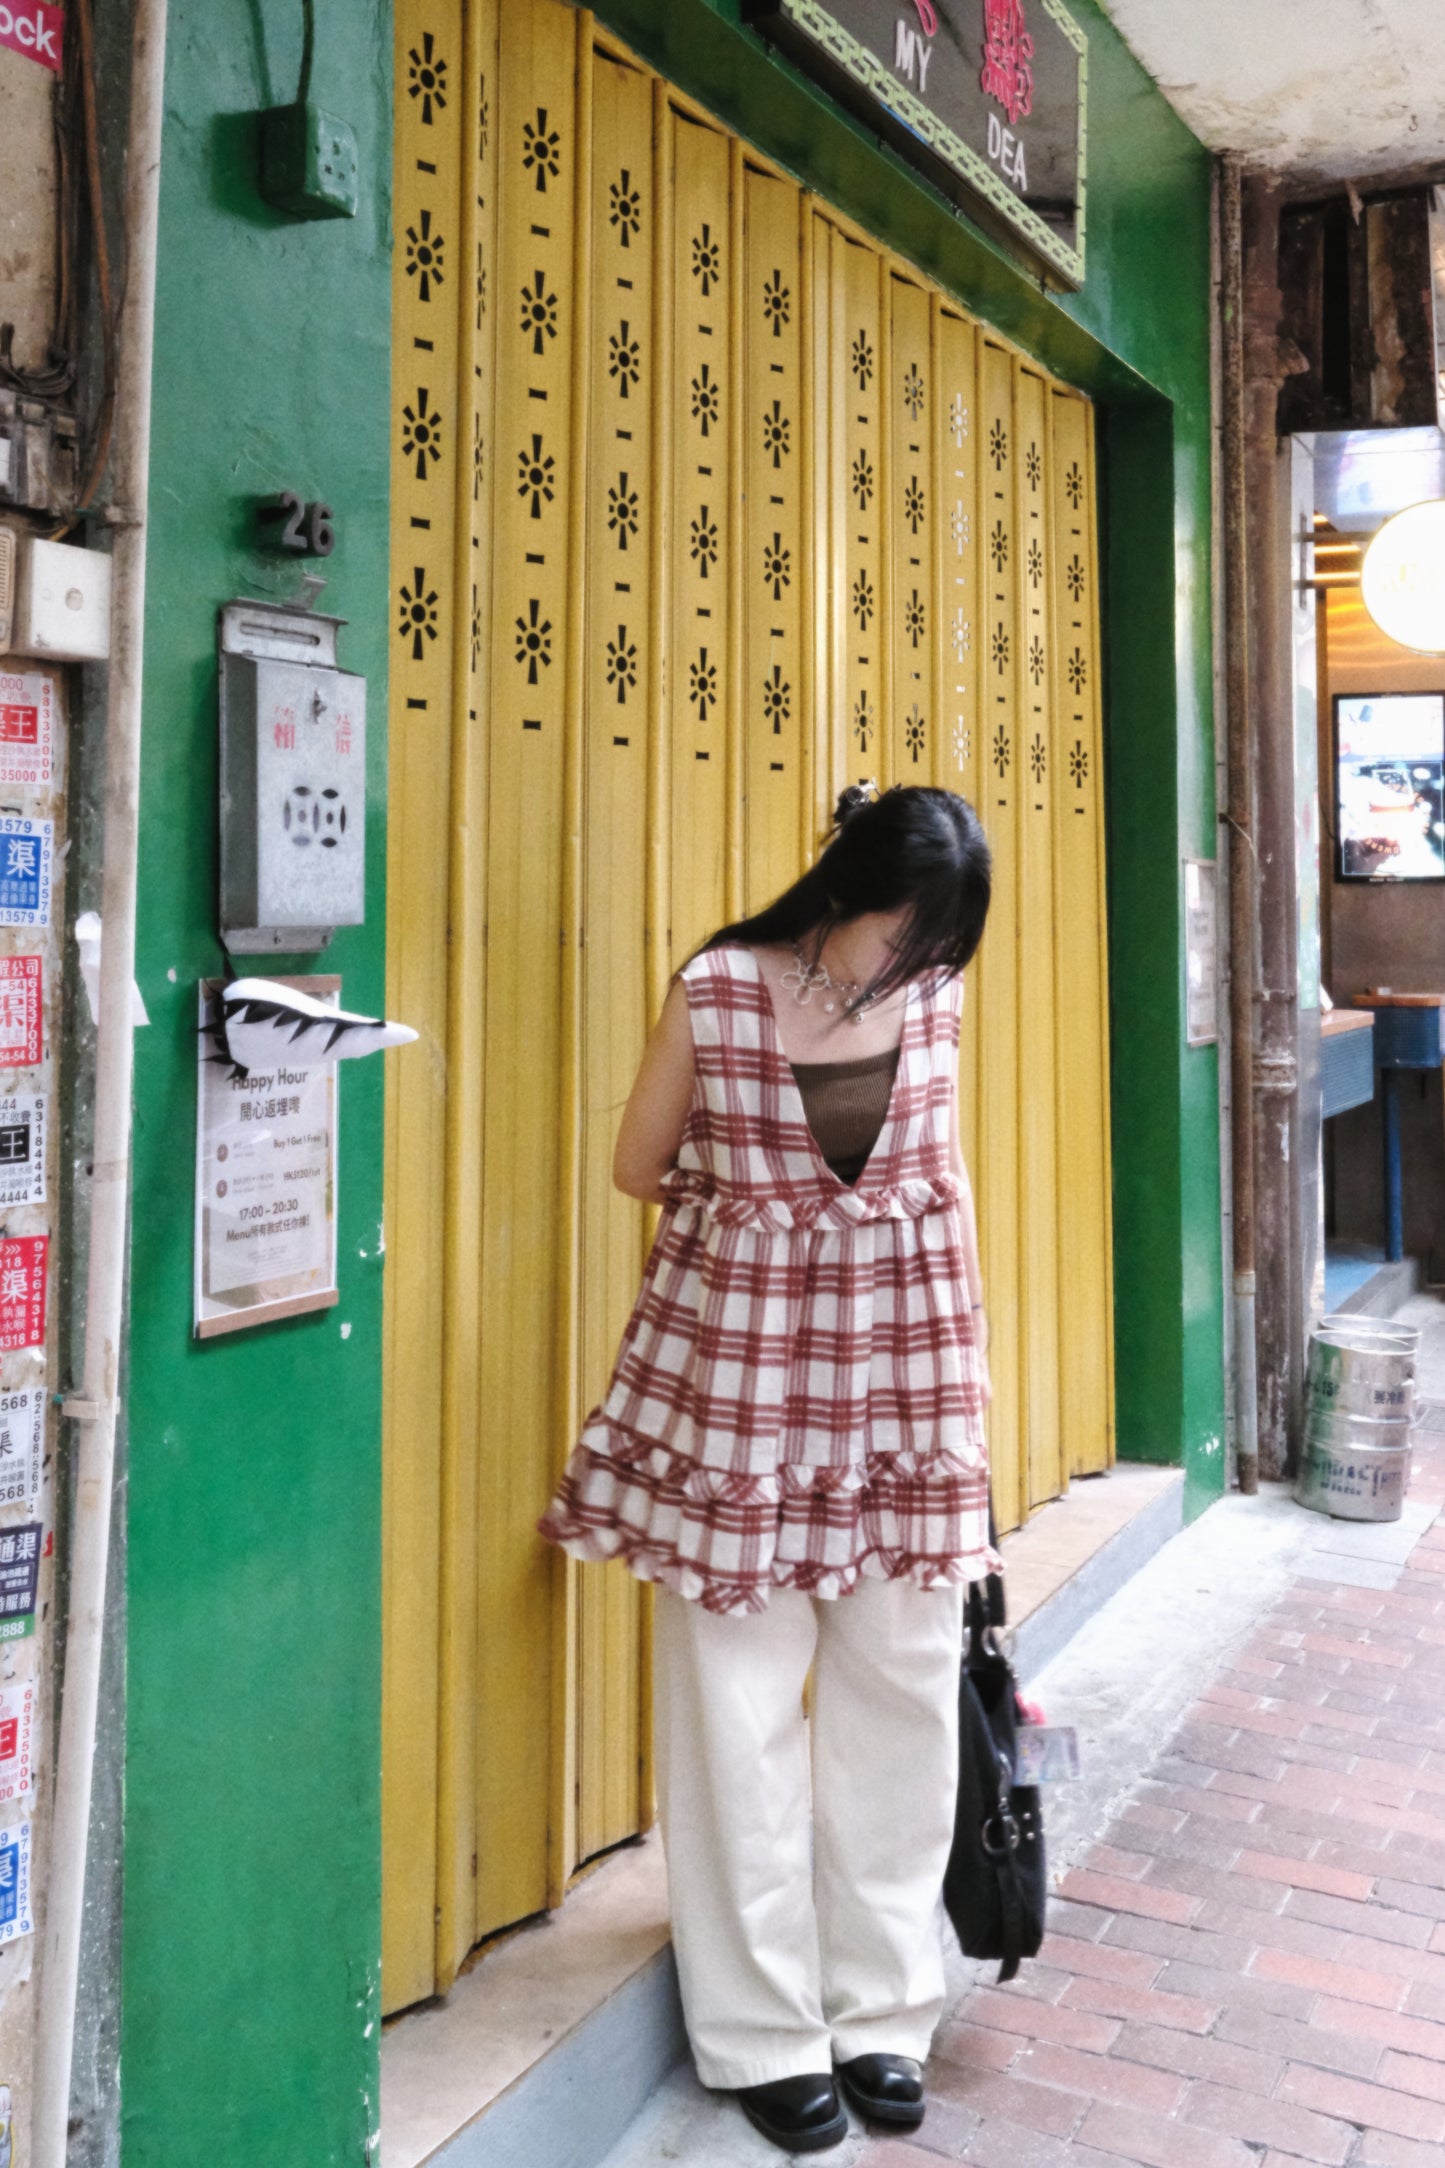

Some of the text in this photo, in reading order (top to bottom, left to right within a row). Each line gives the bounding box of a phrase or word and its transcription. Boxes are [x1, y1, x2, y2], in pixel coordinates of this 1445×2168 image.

[894, 19, 932, 93] MY
[987, 112, 1028, 191] DEA
[281, 491, 334, 556] 26
[7, 839, 36, 878] 渠
[40, 824, 51, 925] 67913579
[27, 978, 38, 1062] 64337000
[233, 1068, 308, 1094] Happy Hour
[240, 1205, 264, 1221] 17:00
[272, 1198, 298, 1215] 20:30
[2, 1268, 28, 1304] 渠
[31, 1241, 44, 1340] 97564318
[19, 1825, 30, 1932] 67913579
